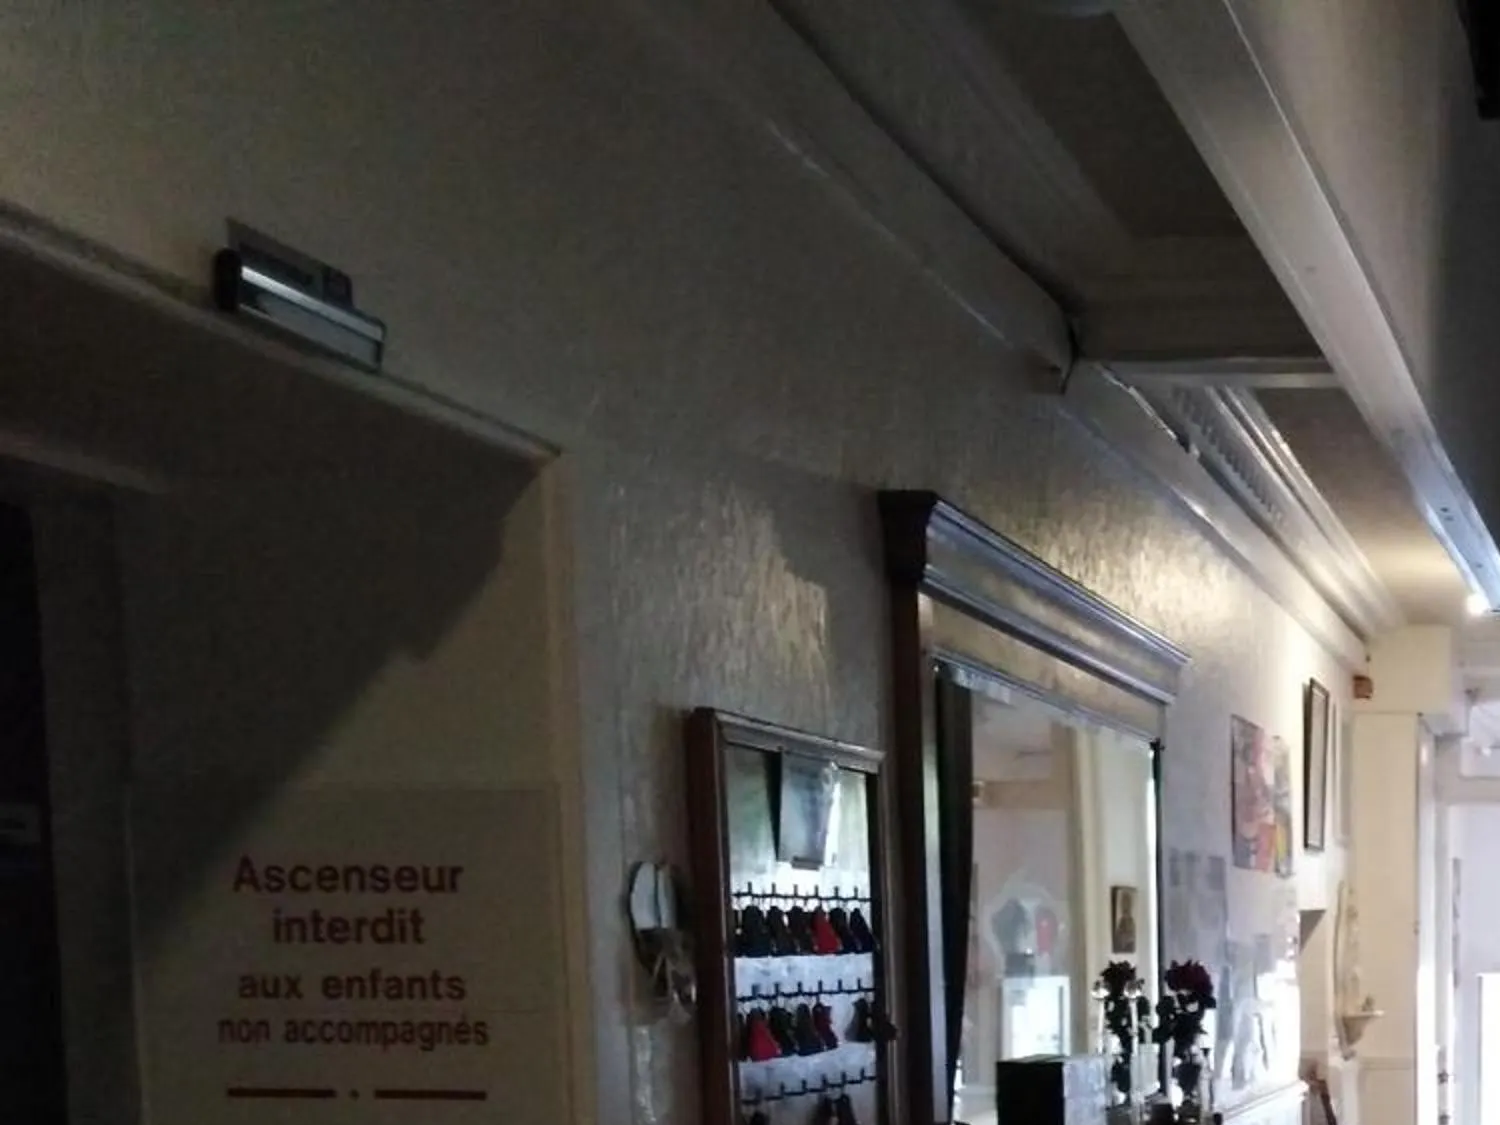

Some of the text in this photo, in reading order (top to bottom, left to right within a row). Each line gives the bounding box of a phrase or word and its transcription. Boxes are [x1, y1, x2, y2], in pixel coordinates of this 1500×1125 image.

[232, 855, 465, 894] Ascenseur
[272, 907, 427, 945] interdit
[237, 968, 467, 1001] aux enfants
[216, 1014, 490, 1053] non accompagnés
